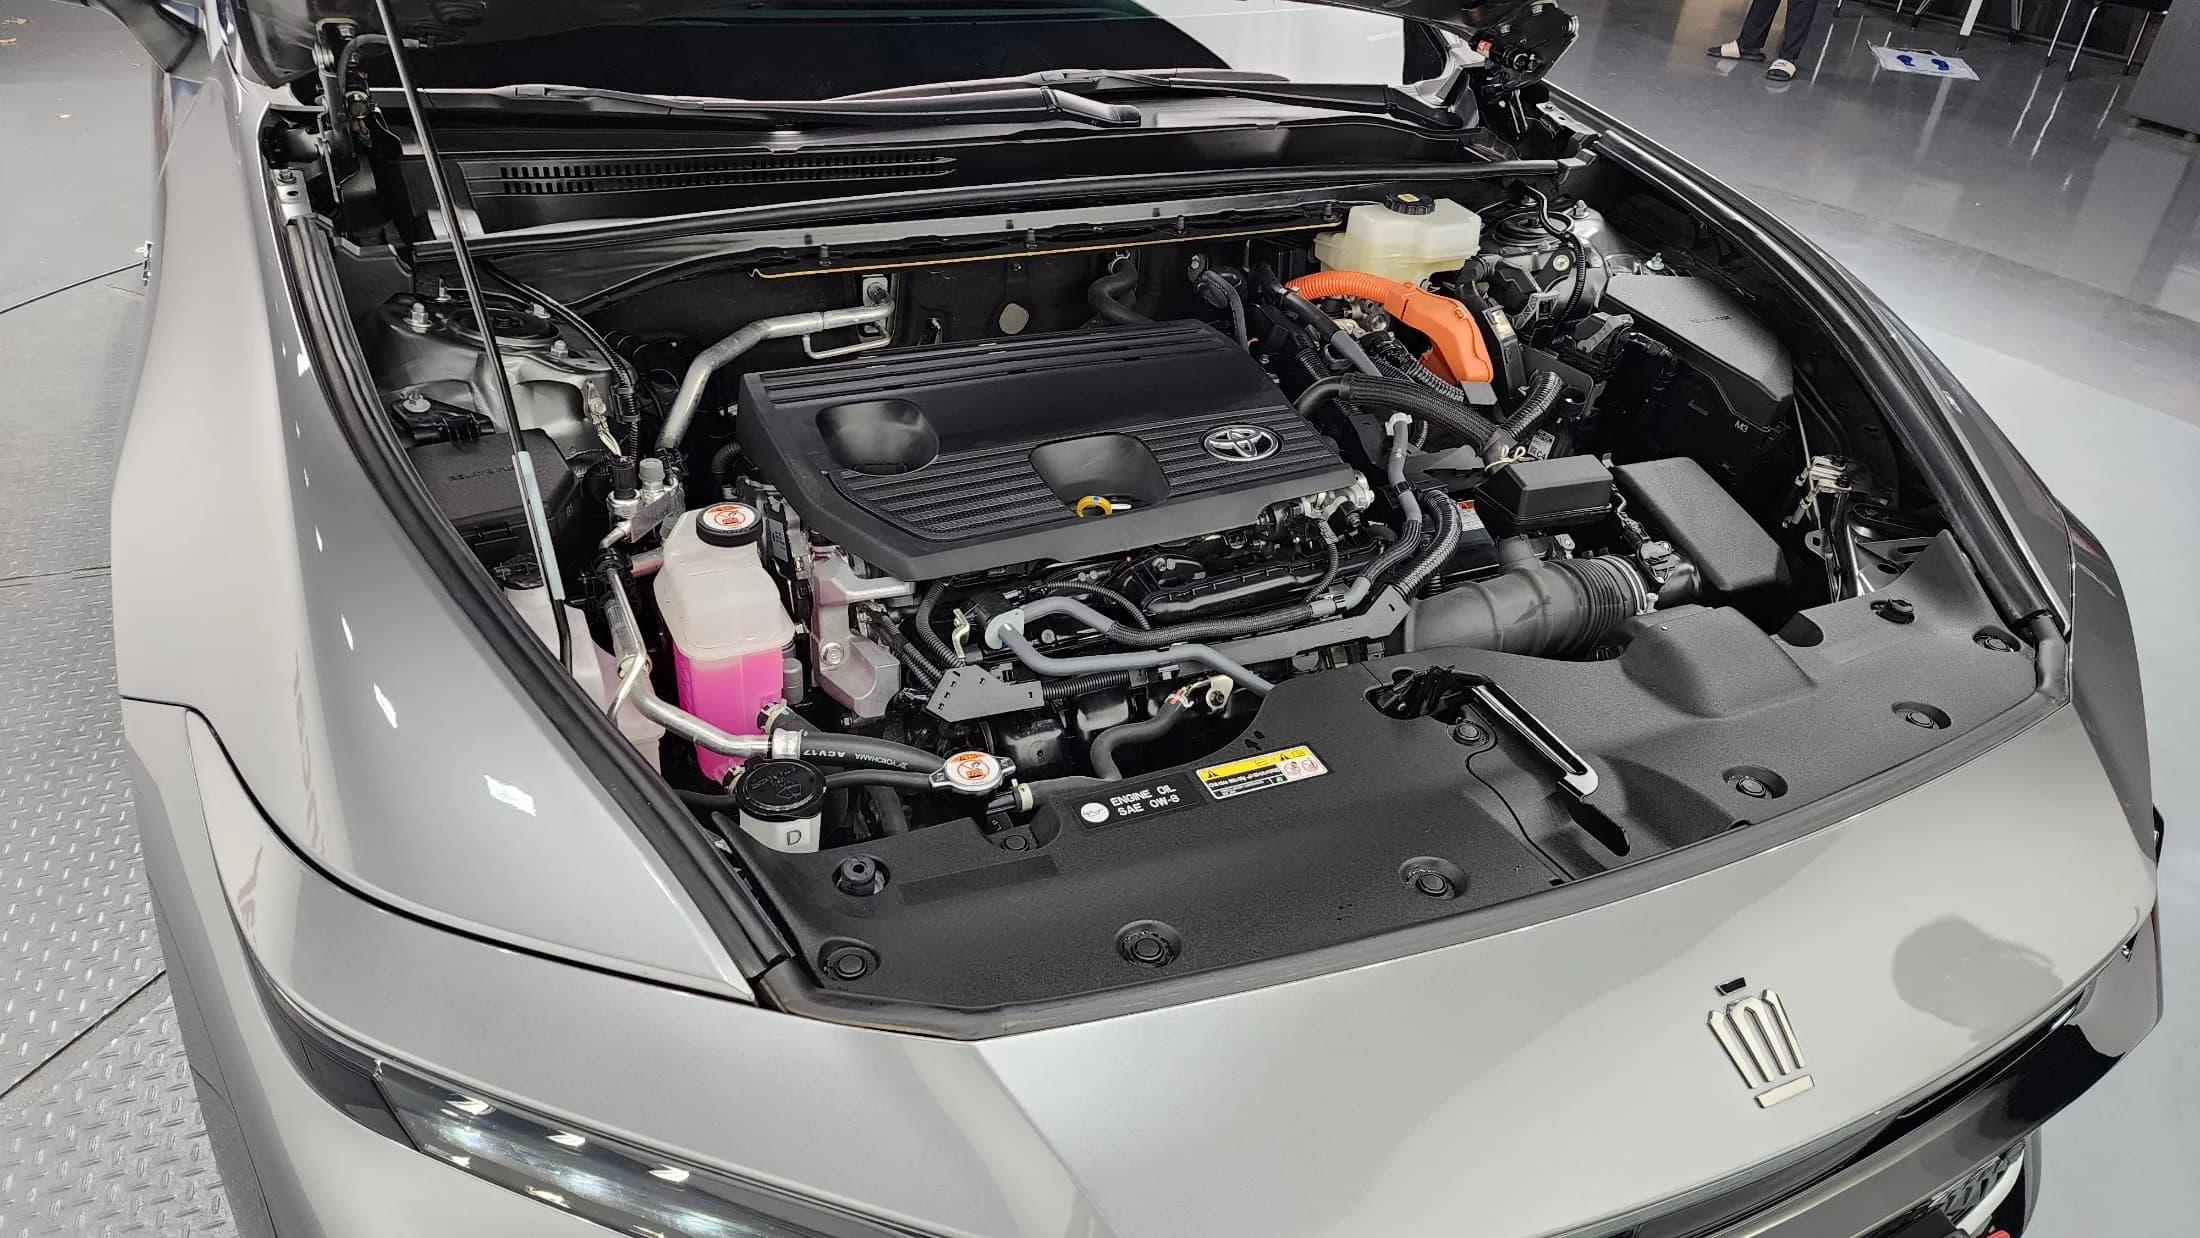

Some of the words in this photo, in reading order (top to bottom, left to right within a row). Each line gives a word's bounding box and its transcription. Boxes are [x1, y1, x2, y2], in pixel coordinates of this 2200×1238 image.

[854, 752, 899, 767] YOKOHAMA
[1110, 789, 1153, 806] ENGINE
[1156, 784, 1177, 795] OIL
[1117, 802, 1145, 816] SAE
[1149, 794, 1180, 808] 0W-8
